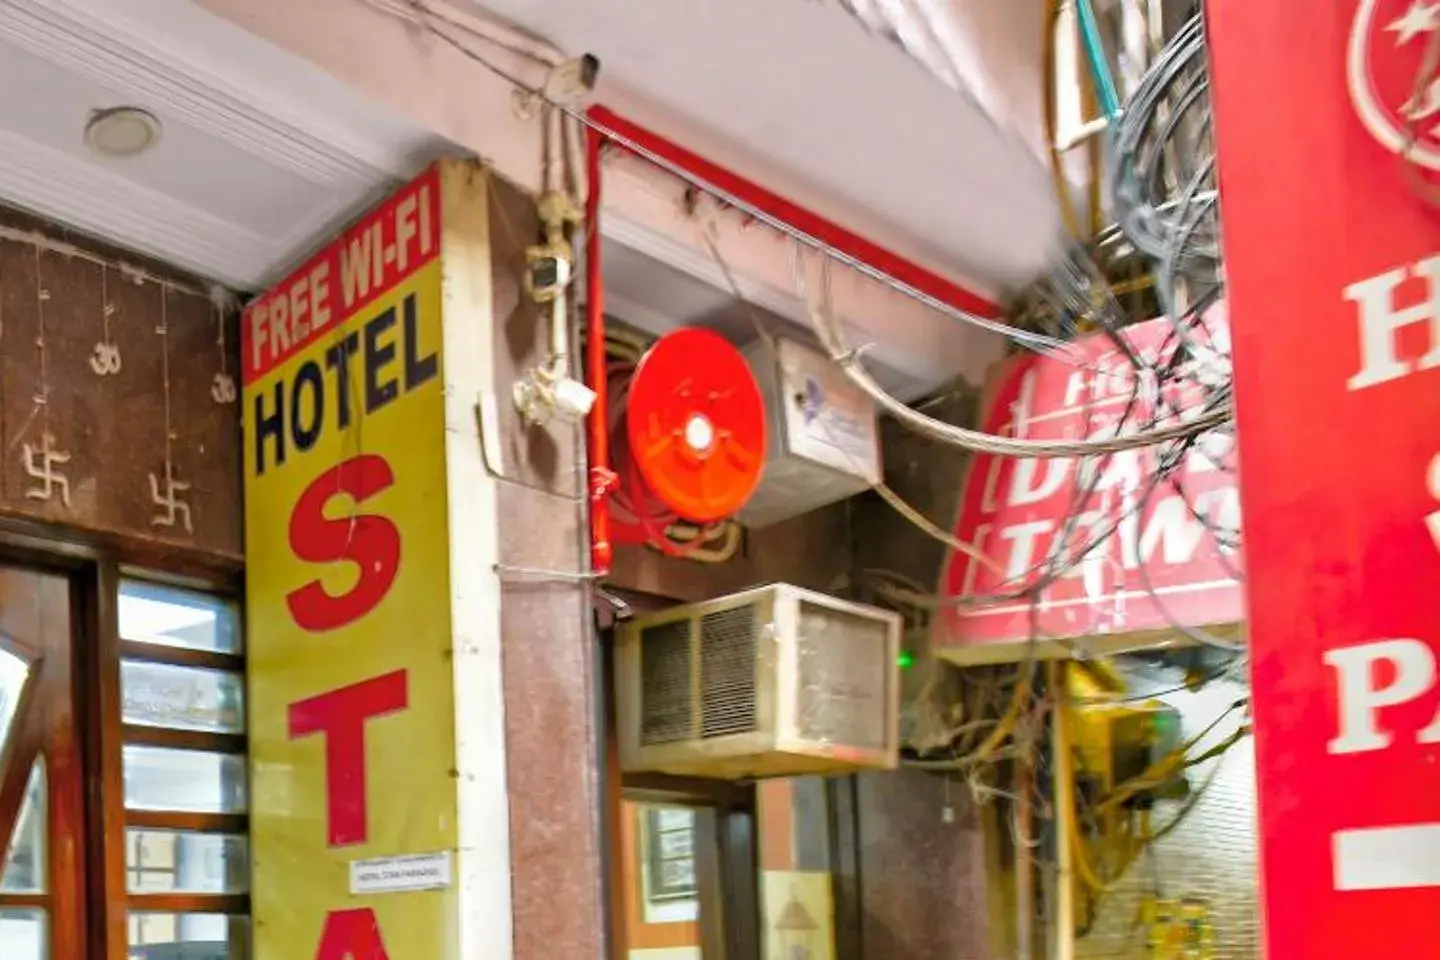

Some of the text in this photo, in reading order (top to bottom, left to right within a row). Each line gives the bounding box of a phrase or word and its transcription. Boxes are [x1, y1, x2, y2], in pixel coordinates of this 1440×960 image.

[250, 184, 433, 372] FREE WI-FI
[254, 291, 439, 479] HOTEL
